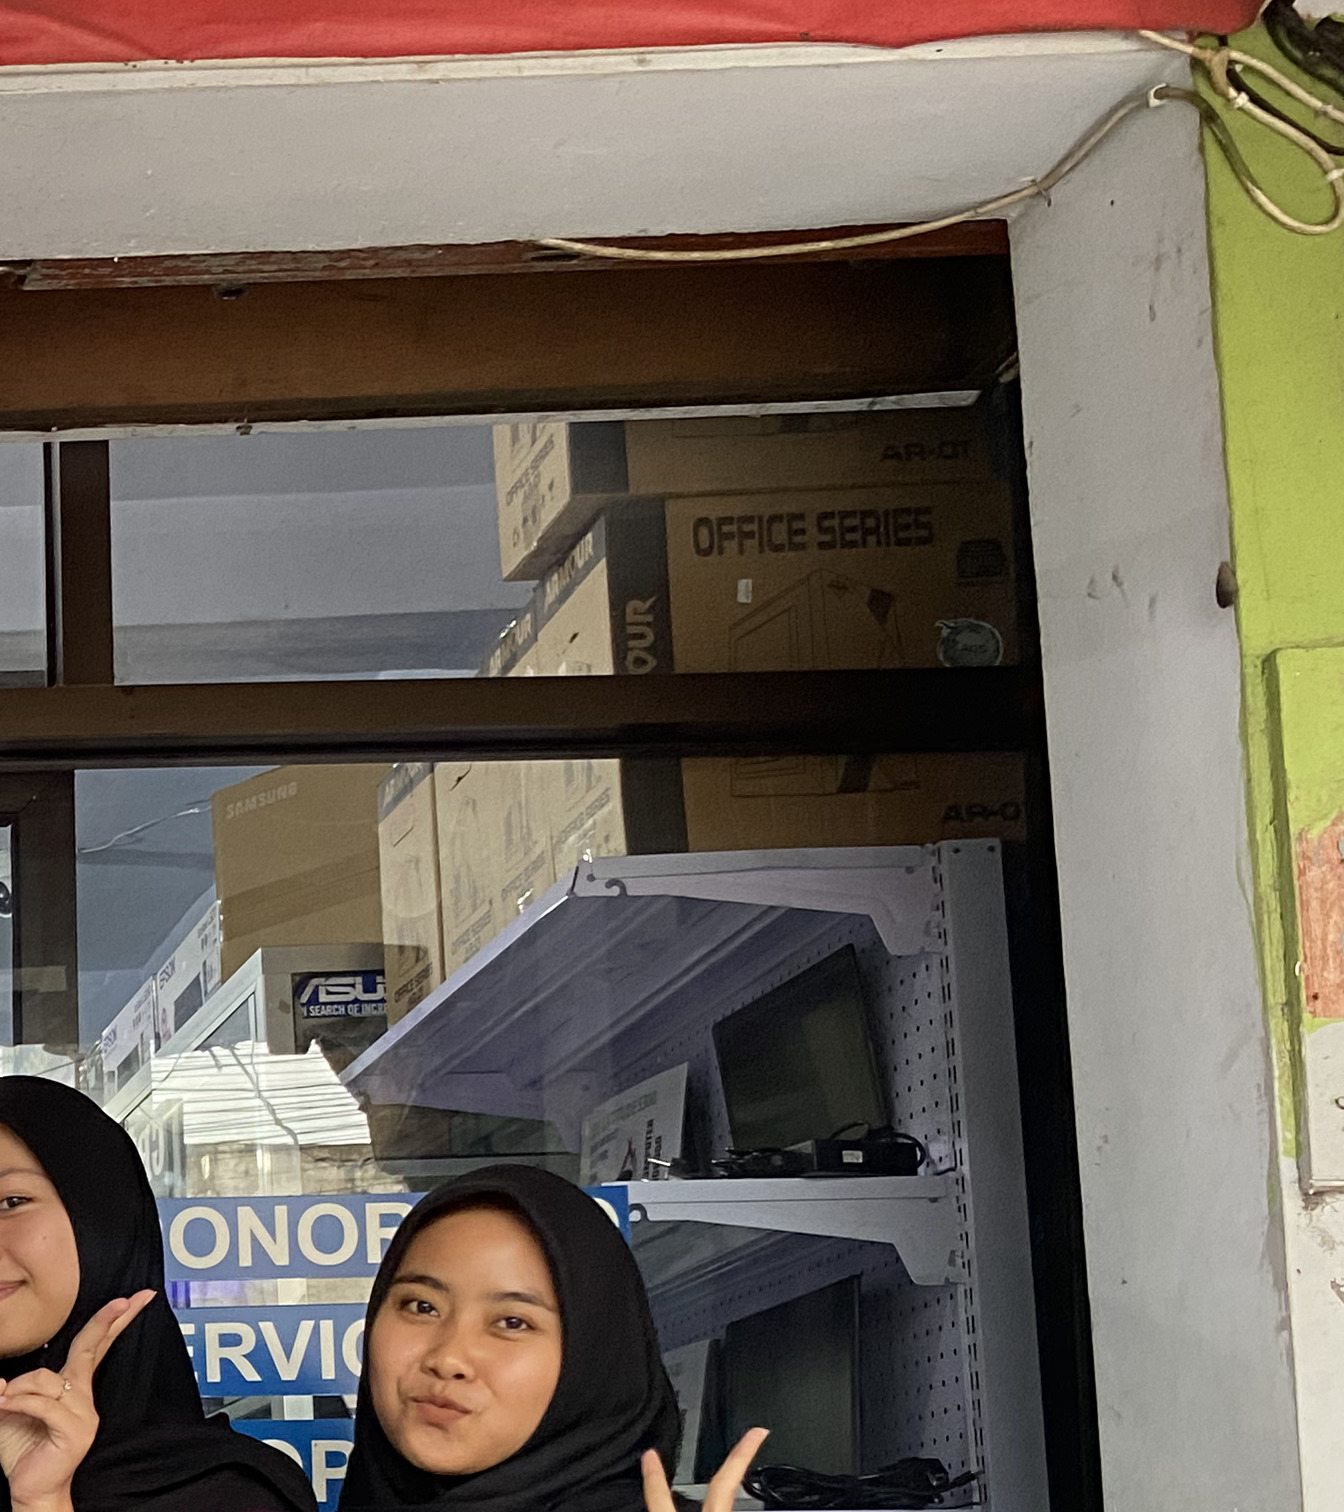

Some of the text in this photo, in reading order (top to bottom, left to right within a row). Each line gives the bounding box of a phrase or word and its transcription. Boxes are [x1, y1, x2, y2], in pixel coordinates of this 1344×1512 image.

[692, 505, 934, 558] OFFICE SERIES
[309, 1004, 345, 1017] SEARCH
